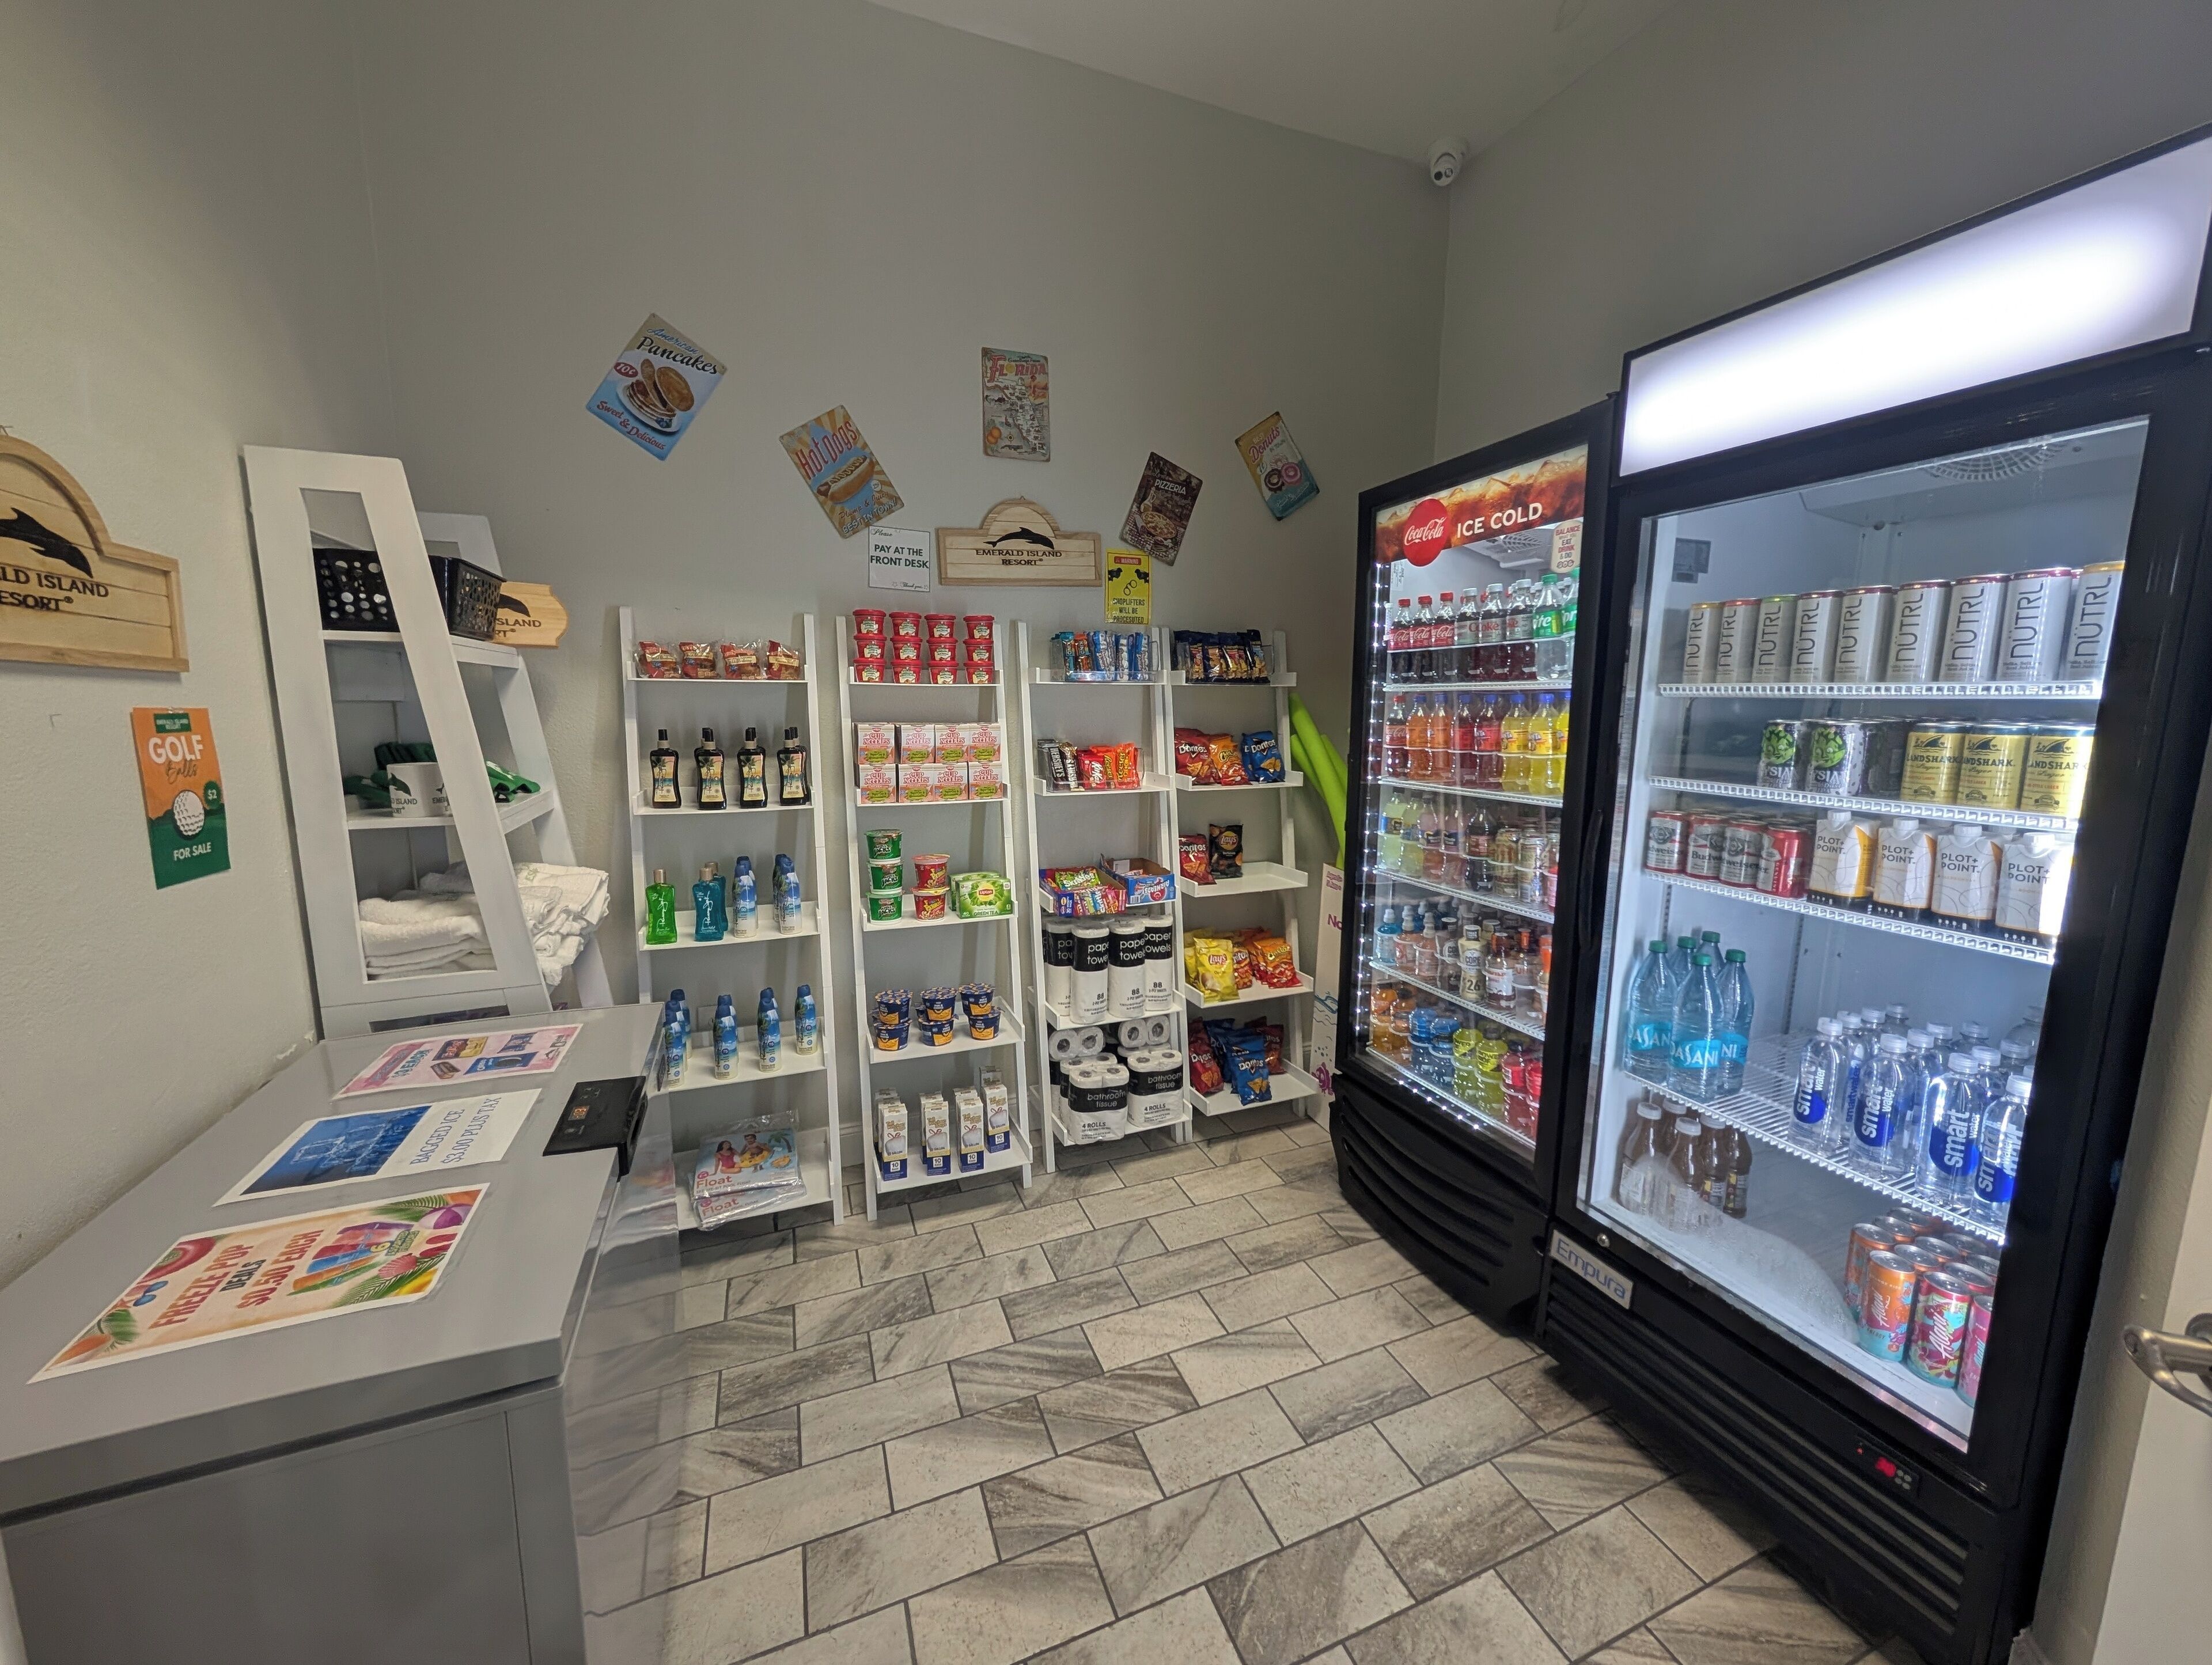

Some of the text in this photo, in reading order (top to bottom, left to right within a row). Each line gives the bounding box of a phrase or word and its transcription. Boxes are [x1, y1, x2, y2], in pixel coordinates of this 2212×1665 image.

[647, 328, 699, 354] American
[637, 336, 717, 374] Pancakes
[597, 401, 666, 450] Sweet & Delicious
[796, 421, 858, 480] Hot Dogs
[1249, 426, 1280, 463] Donuts
[1154, 479, 1187, 495] PIZZERIA
[872, 491, 889, 506] Juicy
[842, 517, 862, 534] BEST
[863, 511, 874, 523] IN
[1457, 517, 1485, 538] ICE
[1490, 502, 1543, 529] COLD
[1556, 525, 1580, 536] BALANCE
[874, 544, 892, 553] PAY
[907, 548, 923, 556] THE
[1558, 544, 1574, 553] DRINK
[870, 555, 929, 568] FRONT DESK
[36, 573, 109, 597] ISLAND
[1113, 598, 1145, 606] SHOPLIFTERS
[496, 618, 541, 627] SLAND
[1113, 615, 1144, 623] PROCESUTED
[149, 735, 203, 764] GOLF
[1179, 744, 1207, 753] Doritos
[1251, 739, 1276, 753] Doritos
[208, 789, 217, 800] $2
[1817, 836, 1844, 845] PLOT+
[173, 842, 211, 861] FOR SALE
[1882, 845, 1914, 855] PLOT+
[1941, 853, 1978, 863] PLOT+
[2008, 863, 2050, 874] PLOT+
[882, 876, 899, 888] JACKS
[1064, 873, 1094, 887] Skittles
[878, 907, 896, 916] JACKS
[1120, 938, 1145, 950] pape
[1146, 945, 1171, 953] owels
[1465, 956, 1481, 966] CORE
[1467, 979, 1480, 991] 26
[1148, 1072, 1182, 1083] bathroom
[1814, 1067, 1826, 1091] water
[1088, 1090, 1126, 1101] bathroom
[1096, 1100, 1118, 1108] tissue
[1861, 1084, 1894, 1139] smart water
[410, 1109, 465, 1165] BAGGED ICE
[440, 1097, 502, 1164] $3.00 PLUS TAX
[1943, 1109, 1970, 1168] smart
[696, 1175, 732, 1189] Float
[702, 1198, 739, 1216] Float
[370, 1241, 391, 1253] 6
[218, 1259, 267, 1292] DEALS
[236, 1229, 324, 1310] $0.50 EACH
[1556, 1238, 1626, 1299] Empura
[147, 1244, 254, 1330] FREEZE POP
